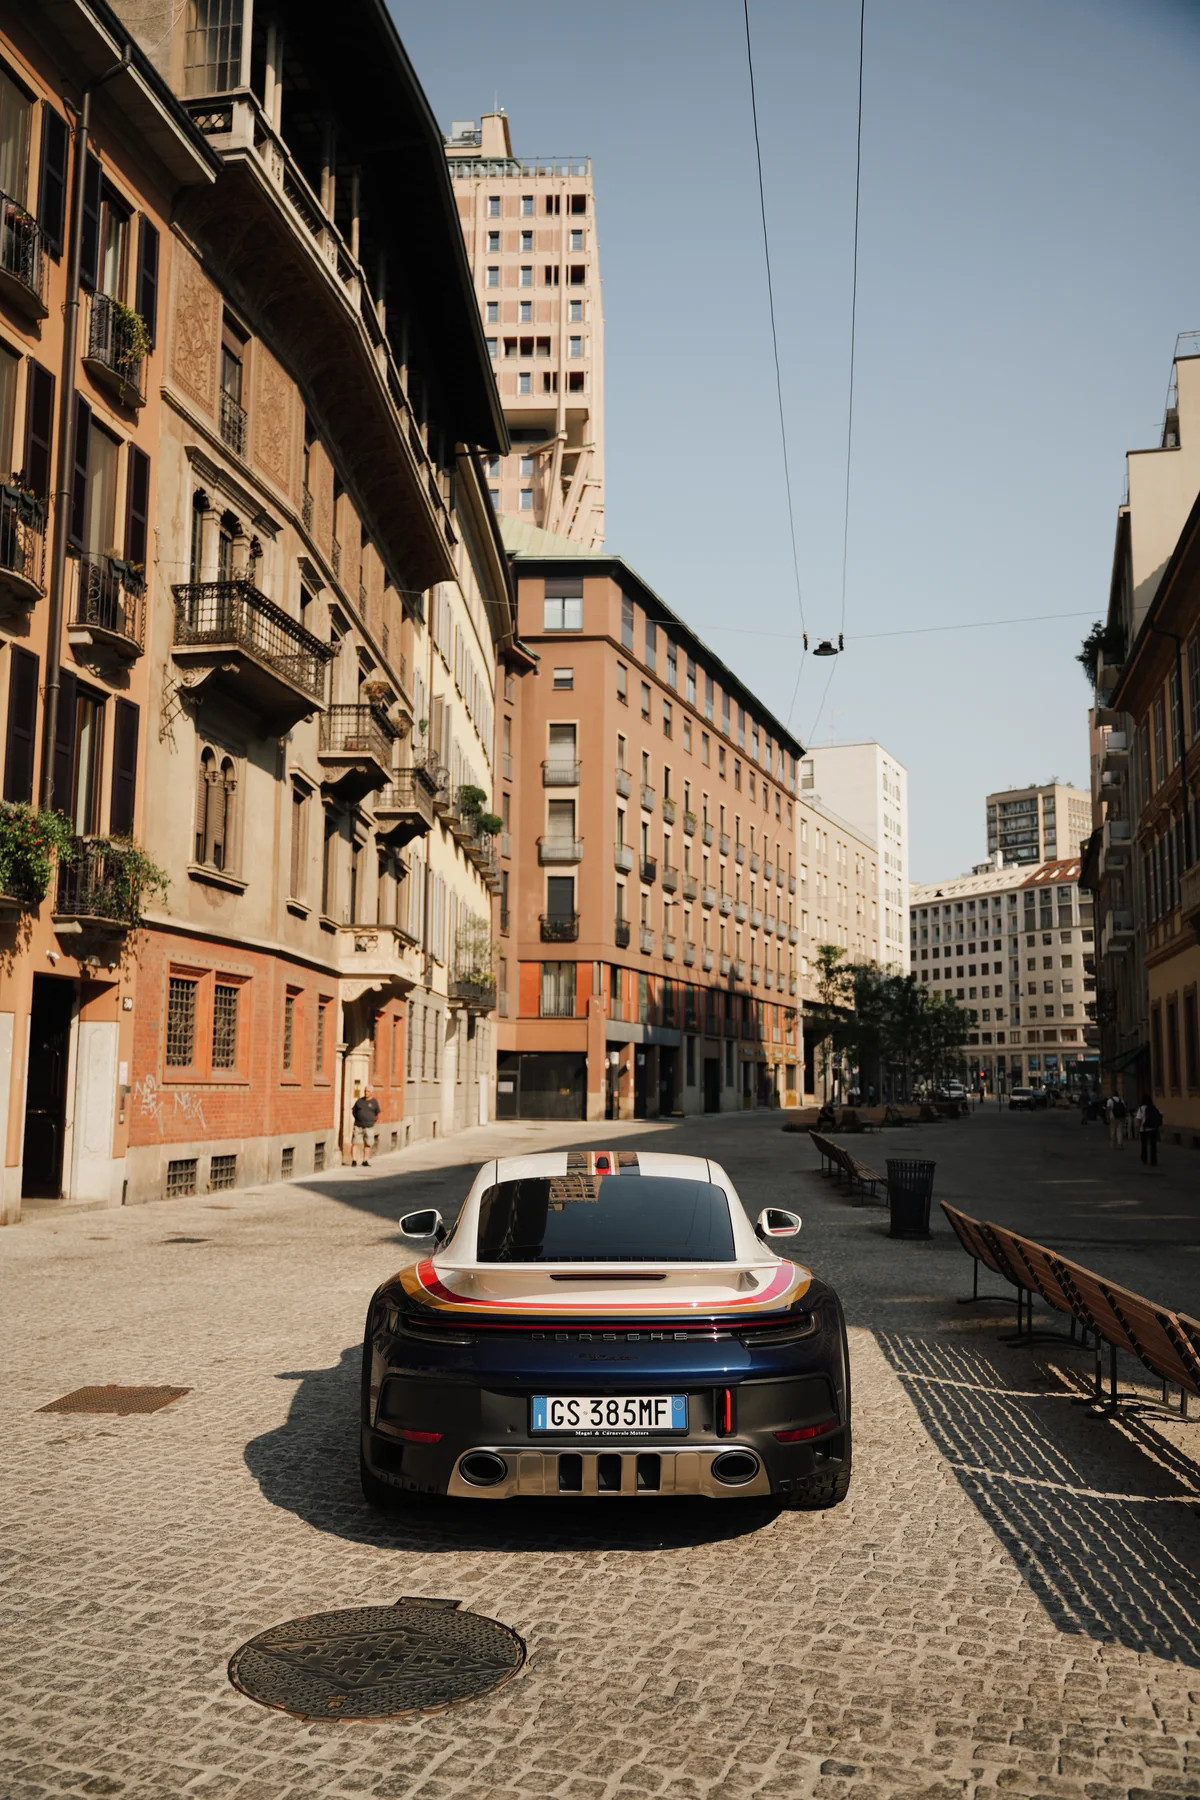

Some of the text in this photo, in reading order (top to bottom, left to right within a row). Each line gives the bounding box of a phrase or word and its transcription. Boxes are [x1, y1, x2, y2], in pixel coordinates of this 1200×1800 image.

[531, 1332, 688, 1341] PORSCHE
[551, 1399, 668, 1426] GS 385MF
[538, 1414, 542, 1426] I
